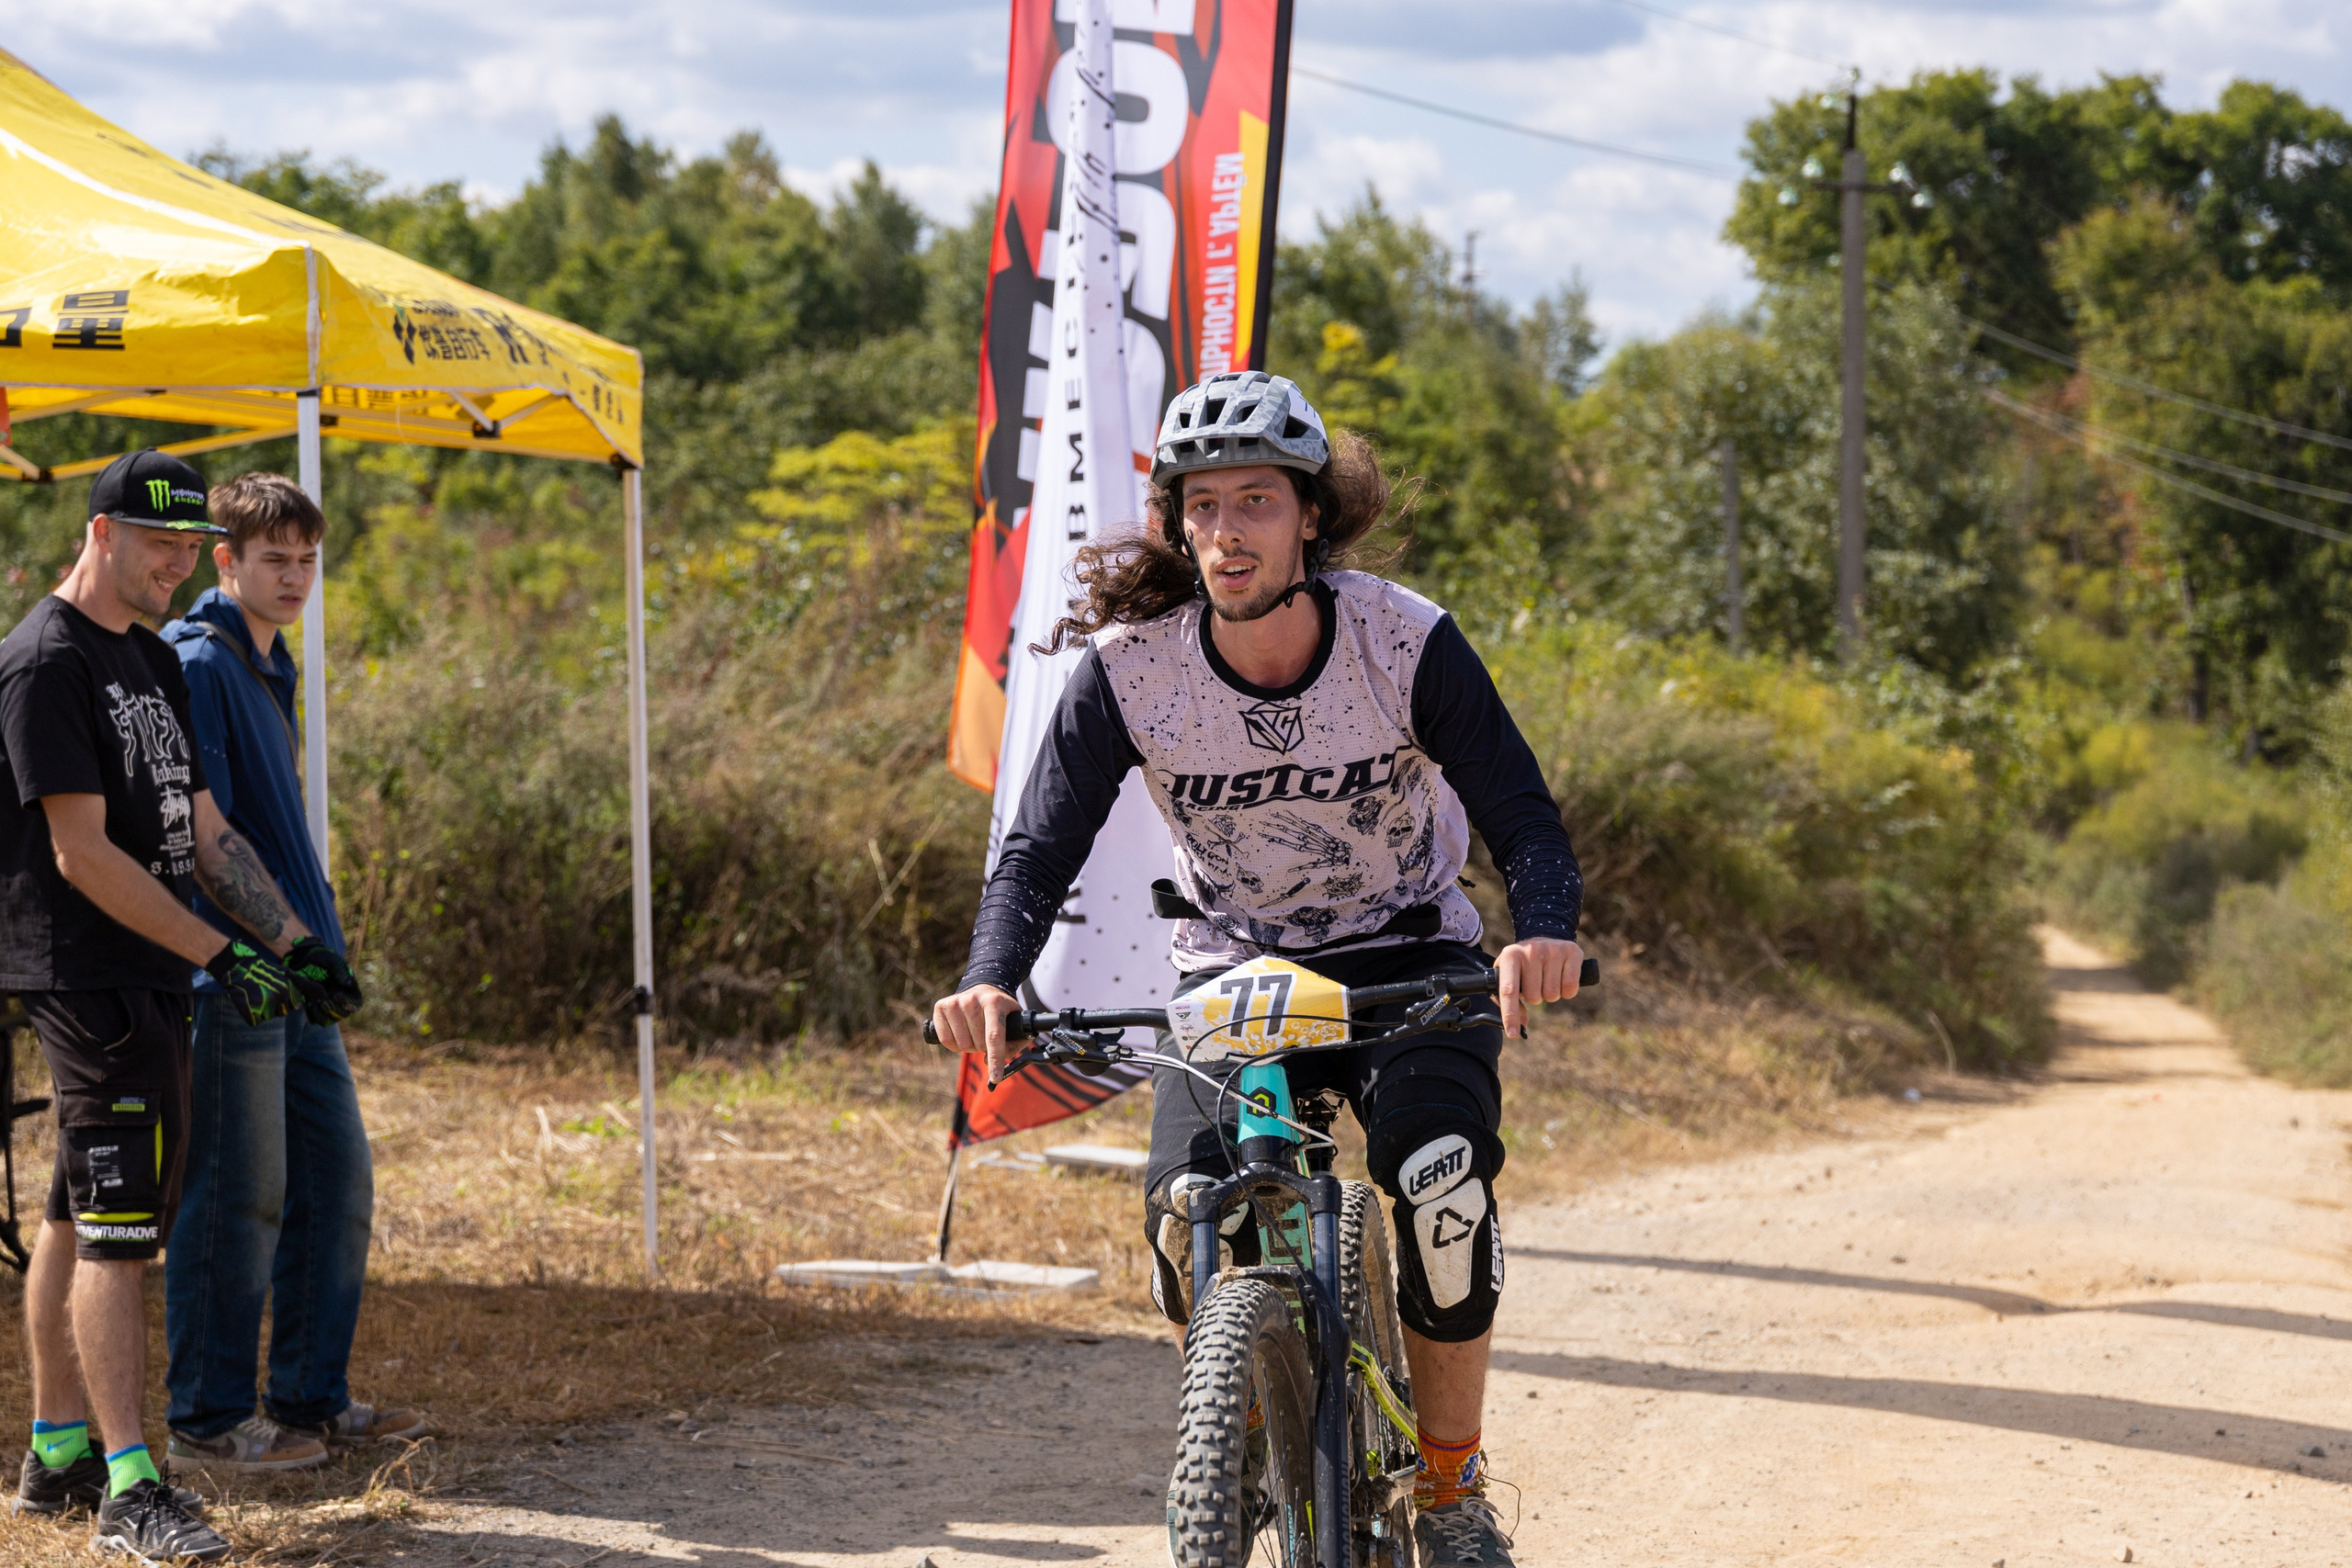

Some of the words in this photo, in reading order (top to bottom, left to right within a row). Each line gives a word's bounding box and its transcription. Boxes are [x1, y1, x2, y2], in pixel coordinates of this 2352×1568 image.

[1220, 974, 1293, 1038] 77
[1409, 1146, 1466, 1196] LEATT
[1489, 1214, 1503, 1293] LEATT
